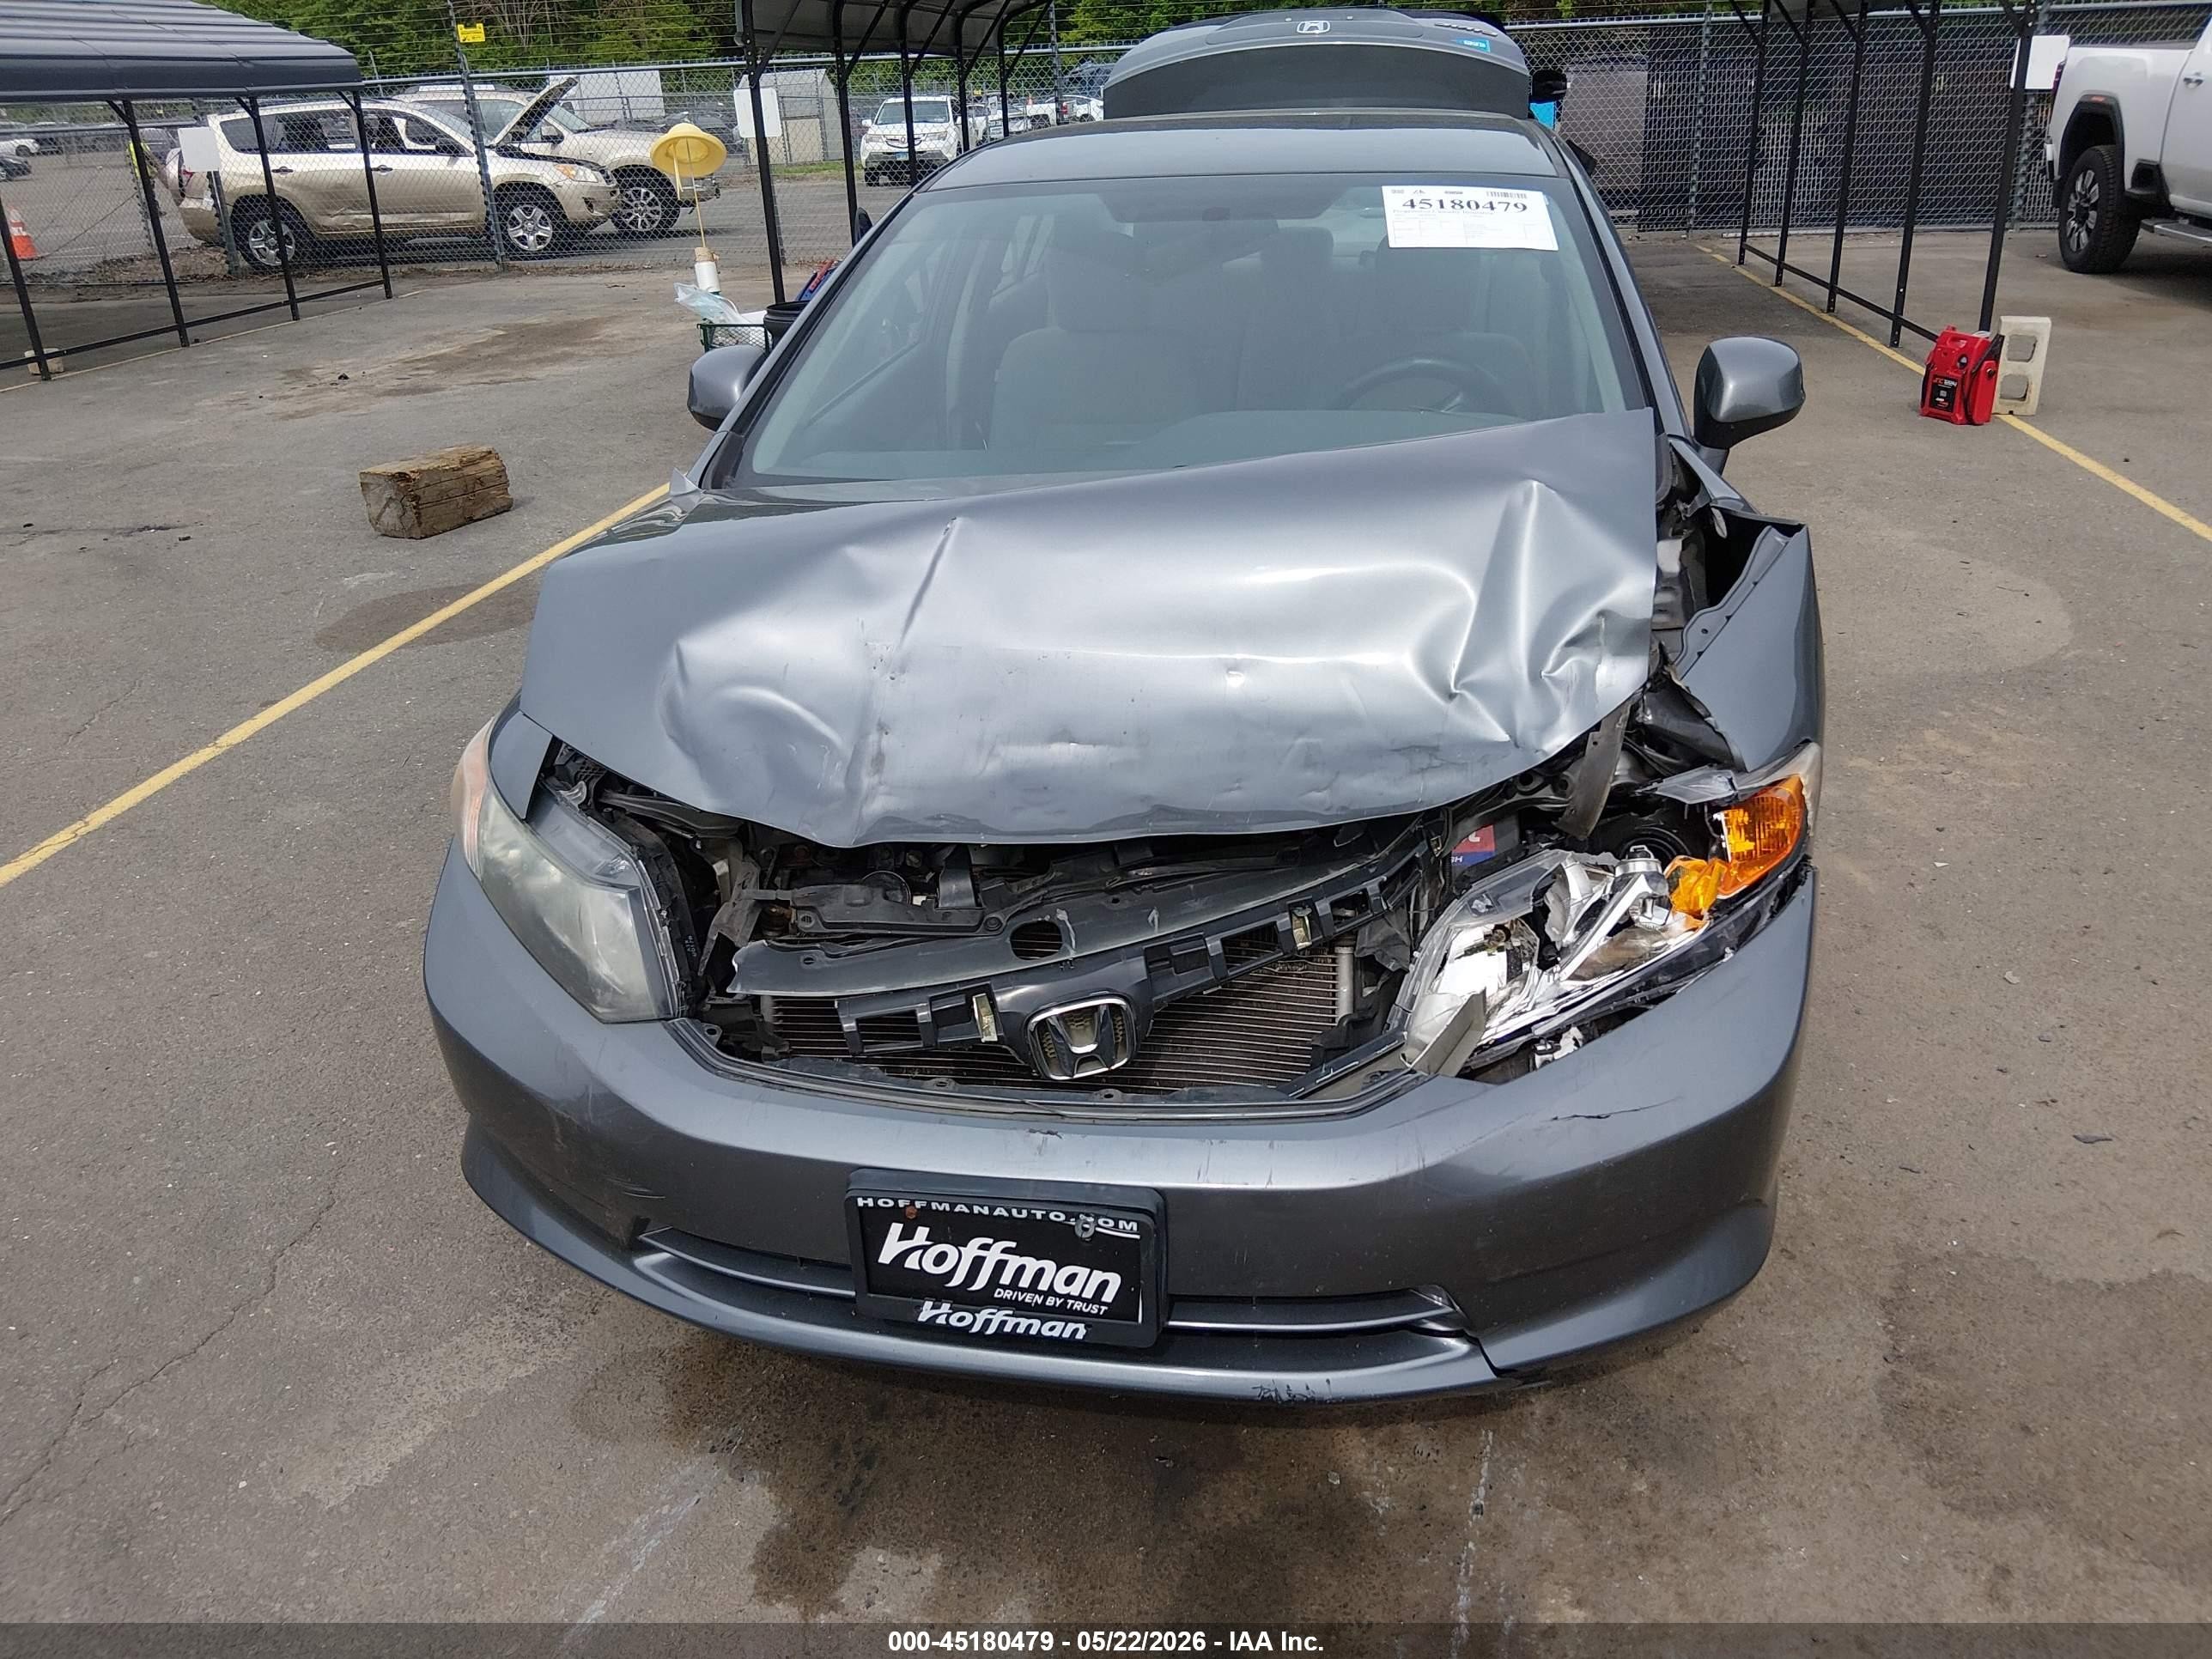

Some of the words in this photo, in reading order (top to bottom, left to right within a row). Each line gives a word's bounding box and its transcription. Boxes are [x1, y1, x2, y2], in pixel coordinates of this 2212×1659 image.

[1402, 198, 1528, 213] 45180479
[878, 1222, 1121, 1304] Hoffman
[994, 1288, 1044, 1305] DRIVEN
[1045, 1296, 1065, 1308] BY
[1066, 1299, 1109, 1316] TRUST
[917, 1300, 1087, 1340] Hoffman
